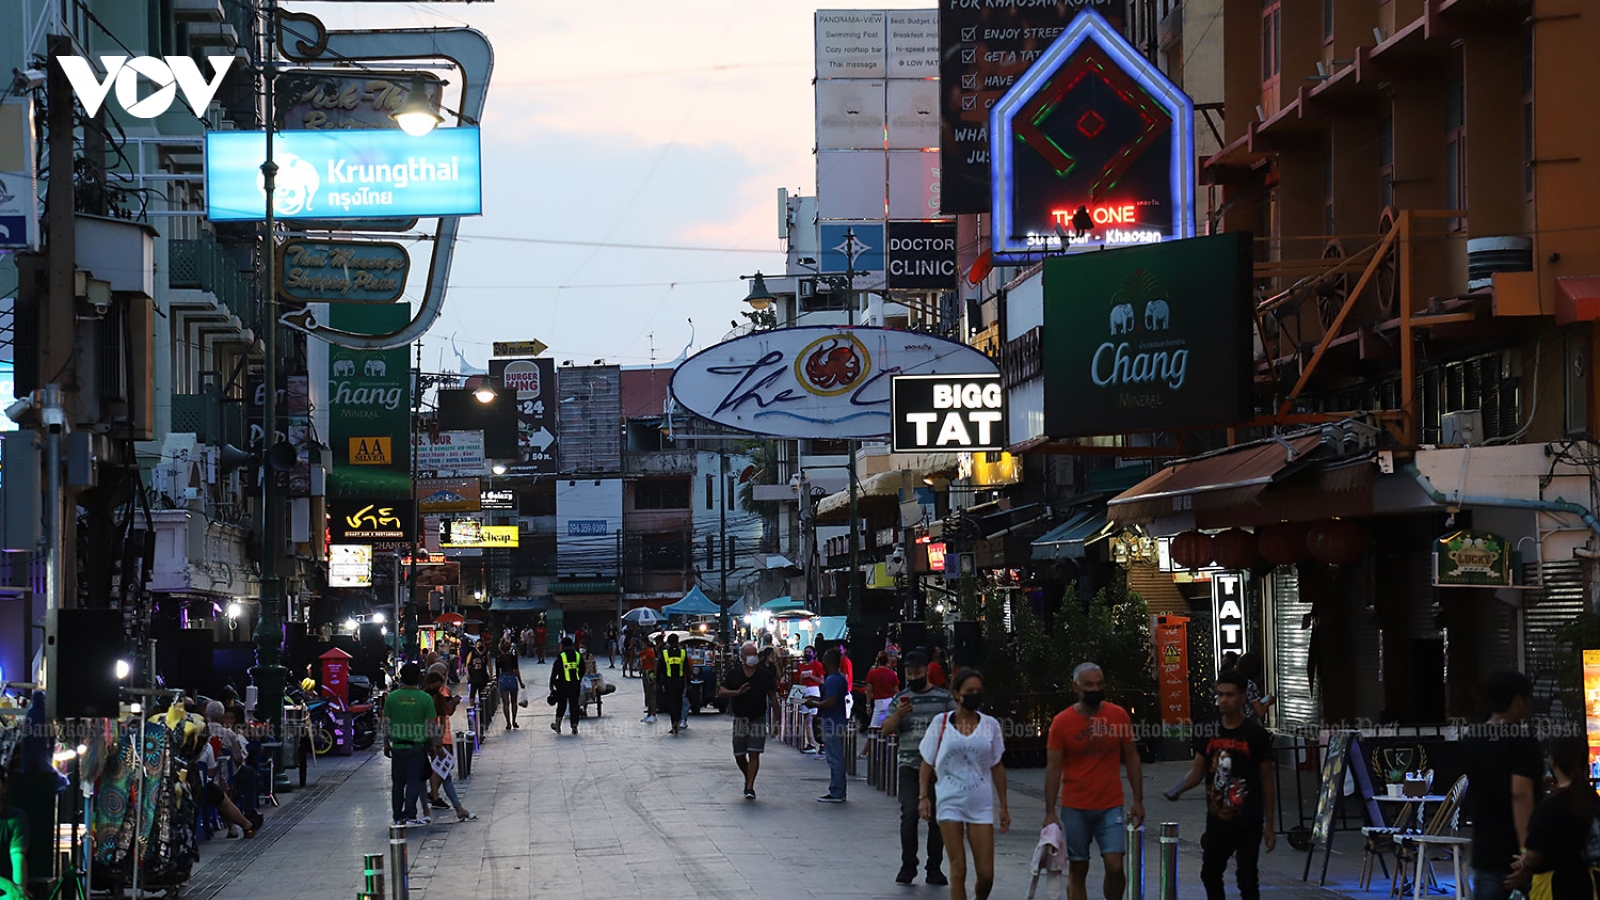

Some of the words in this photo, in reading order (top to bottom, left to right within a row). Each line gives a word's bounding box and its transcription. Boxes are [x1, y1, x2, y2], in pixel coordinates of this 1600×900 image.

[819, 16, 882, 24] PANORAMA-VIEW
[907, 17, 930, 26] Budget
[825, 31, 861, 40] Swimming
[863, 31, 879, 39] Pool
[892, 30, 924, 39] Breakfast
[983, 28, 1022, 40] ENJOY
[825, 46, 842, 54] Cozy
[844, 45, 869, 54] rooftop
[895, 45, 925, 54] hi-speed
[984, 51, 1005, 63] GET
[1007, 51, 1017, 62] A
[984, 75, 1014, 87] HAVE
[327, 156, 459, 188] Krungthai
[328, 187, 393, 212] กรุงไทย
[1052, 208, 1089, 227] TH
[1093, 205, 1136, 225] ONE
[1105, 227, 1163, 244] Khaosan
[889, 238, 955, 251] DOCTOR
[287, 245, 328, 268] Thai
[329, 247, 404, 275] Massage
[889, 259, 956, 276] CLINIC
[287, 267, 352, 295] Shopping
[1090, 342, 1189, 390] Chang
[505, 372, 538, 380] BURGER
[506, 380, 539, 391] KING
[706, 350, 806, 417] The
[340, 408, 380, 419] MINERAL
[524, 400, 545, 415] 24
[357, 438, 383, 456] AA
[354, 454, 386, 462] SILVER
[1457, 553, 1492, 565] LUCKY
[1218, 577, 1243, 656] TAT
[1395, 752, 1406, 766] K
